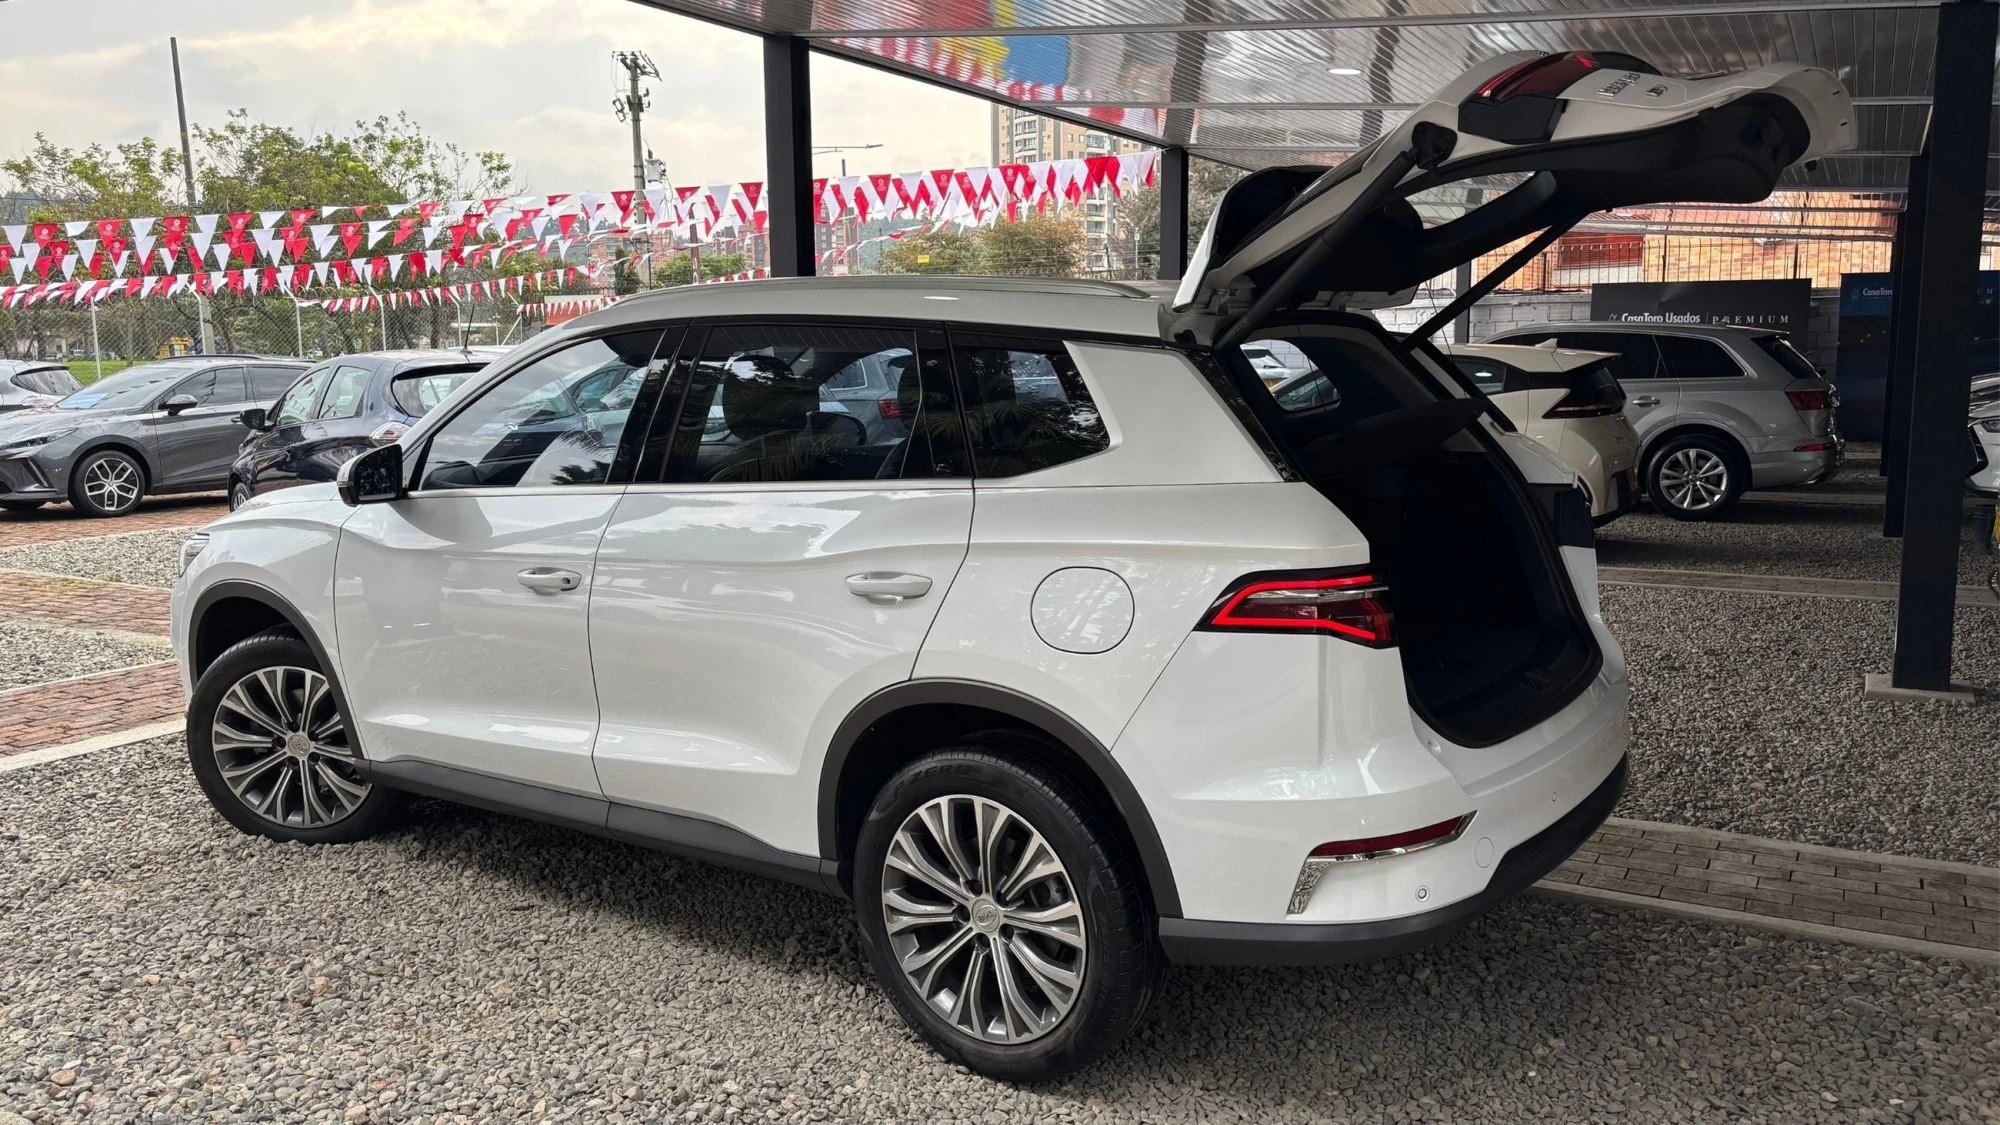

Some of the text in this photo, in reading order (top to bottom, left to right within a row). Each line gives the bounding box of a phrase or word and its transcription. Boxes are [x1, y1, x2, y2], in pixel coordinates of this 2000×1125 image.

[1665, 312, 1701, 323] Usados
[1712, 315, 1789, 325] PREMIUM
[910, 764, 972, 785] ZERO
